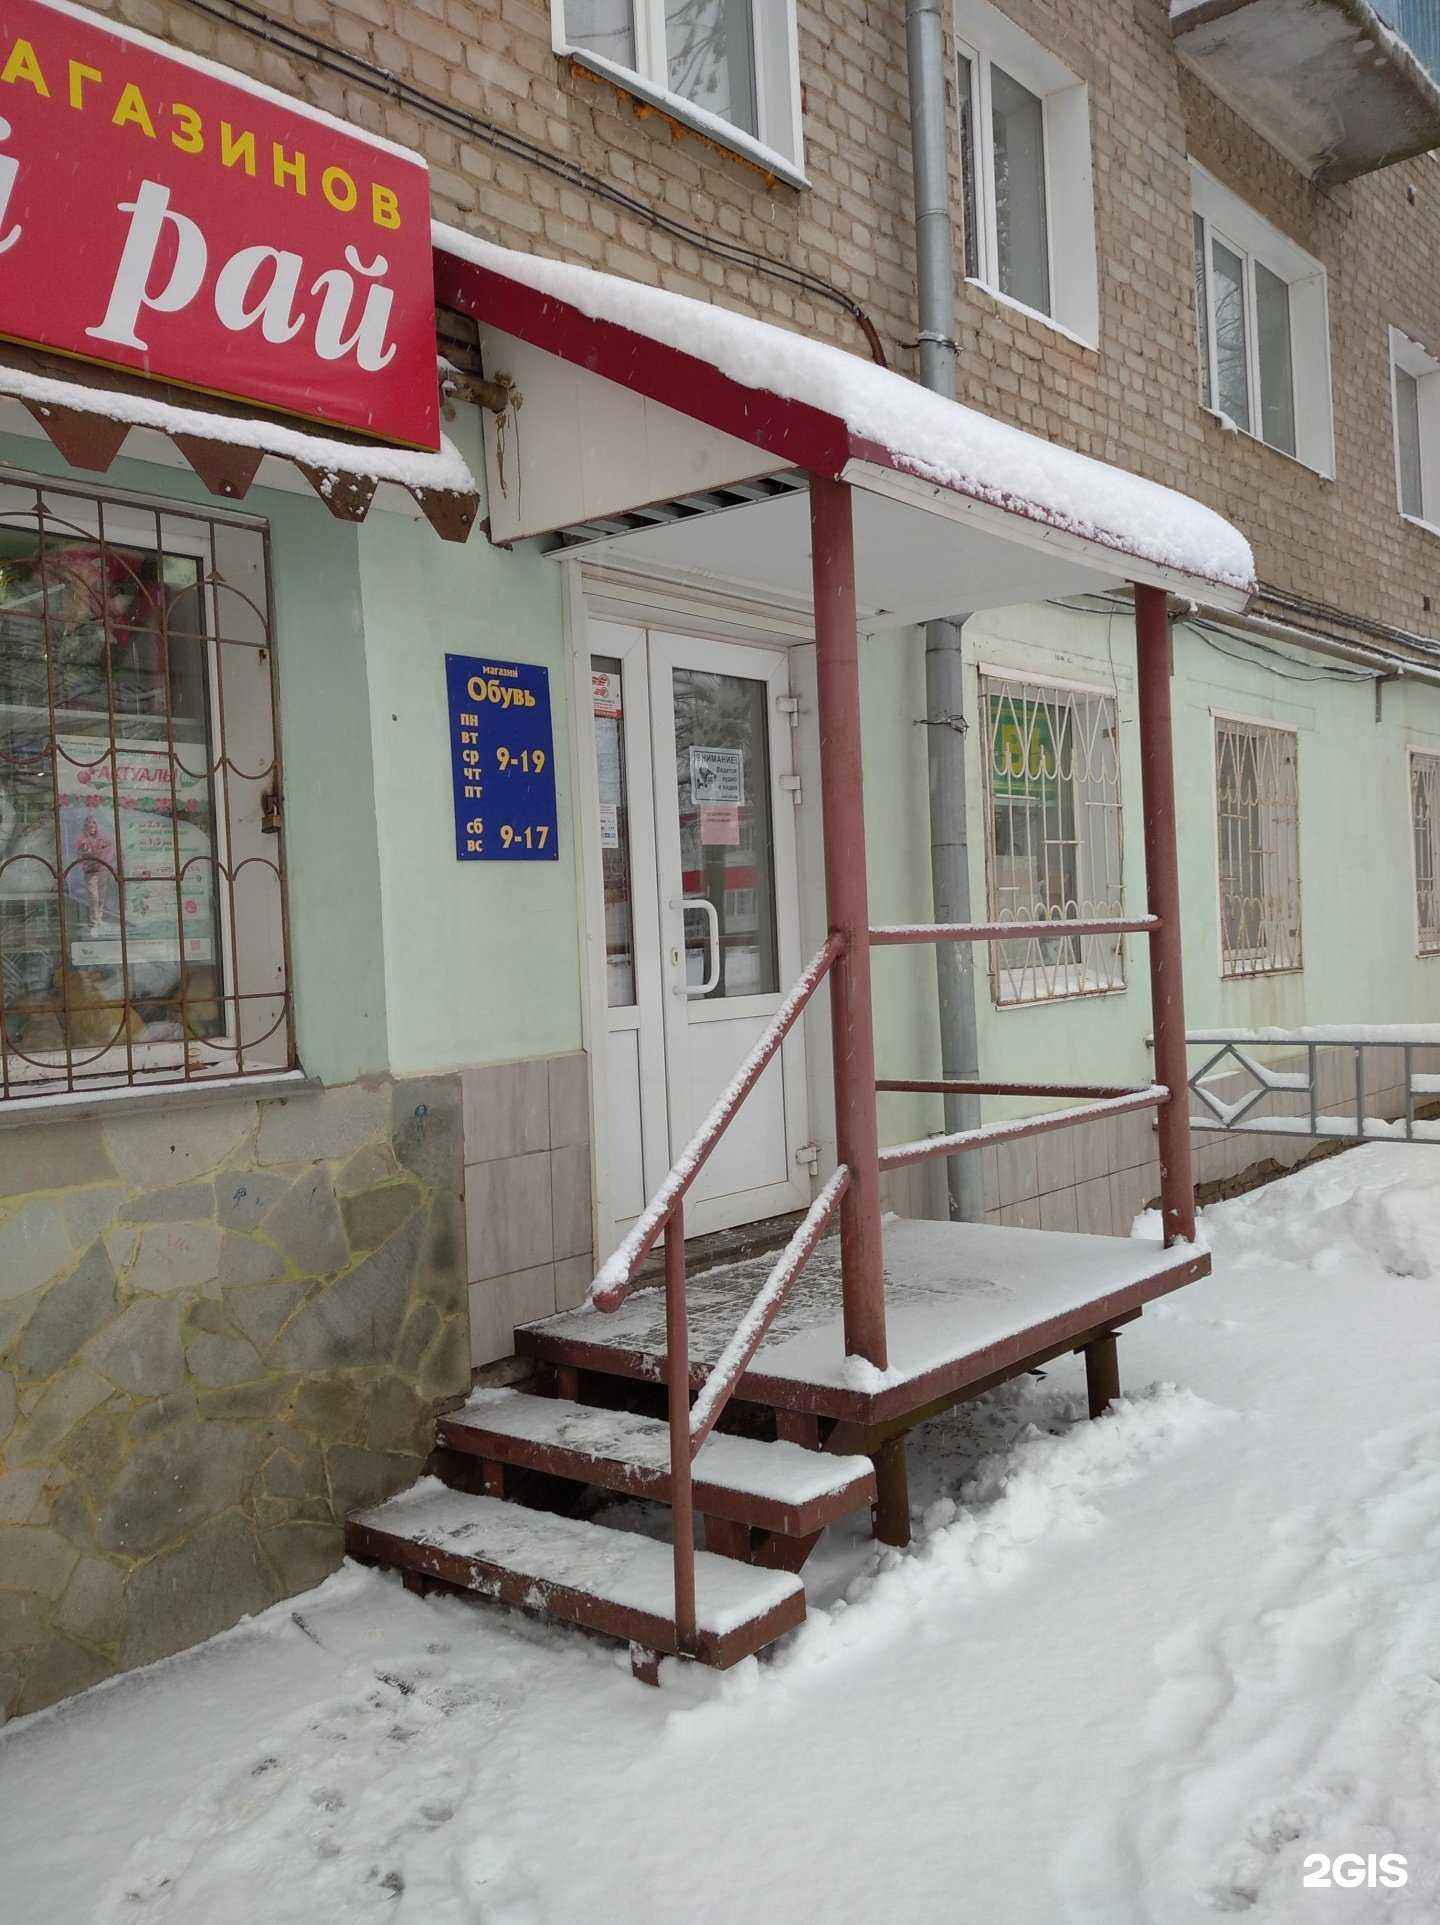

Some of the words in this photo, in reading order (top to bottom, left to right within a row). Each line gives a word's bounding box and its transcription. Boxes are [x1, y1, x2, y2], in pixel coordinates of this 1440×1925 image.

[0, 37, 402, 230] АГАЗИНОВ
[85, 179, 397, 372] рай
[482, 665, 519, 678] магазин
[467, 676, 536, 709] Обувь
[460, 713, 479, 726] пн
[461, 731, 479, 744] вт
[462, 749, 480, 765] ср
[496, 747, 545, 773] 9-19
[464, 768, 482, 780] чт
[464, 786, 483, 798] пт
[466, 818, 484, 834] сб
[500, 825, 549, 849] 9-17
[466, 840, 483, 852] вс
